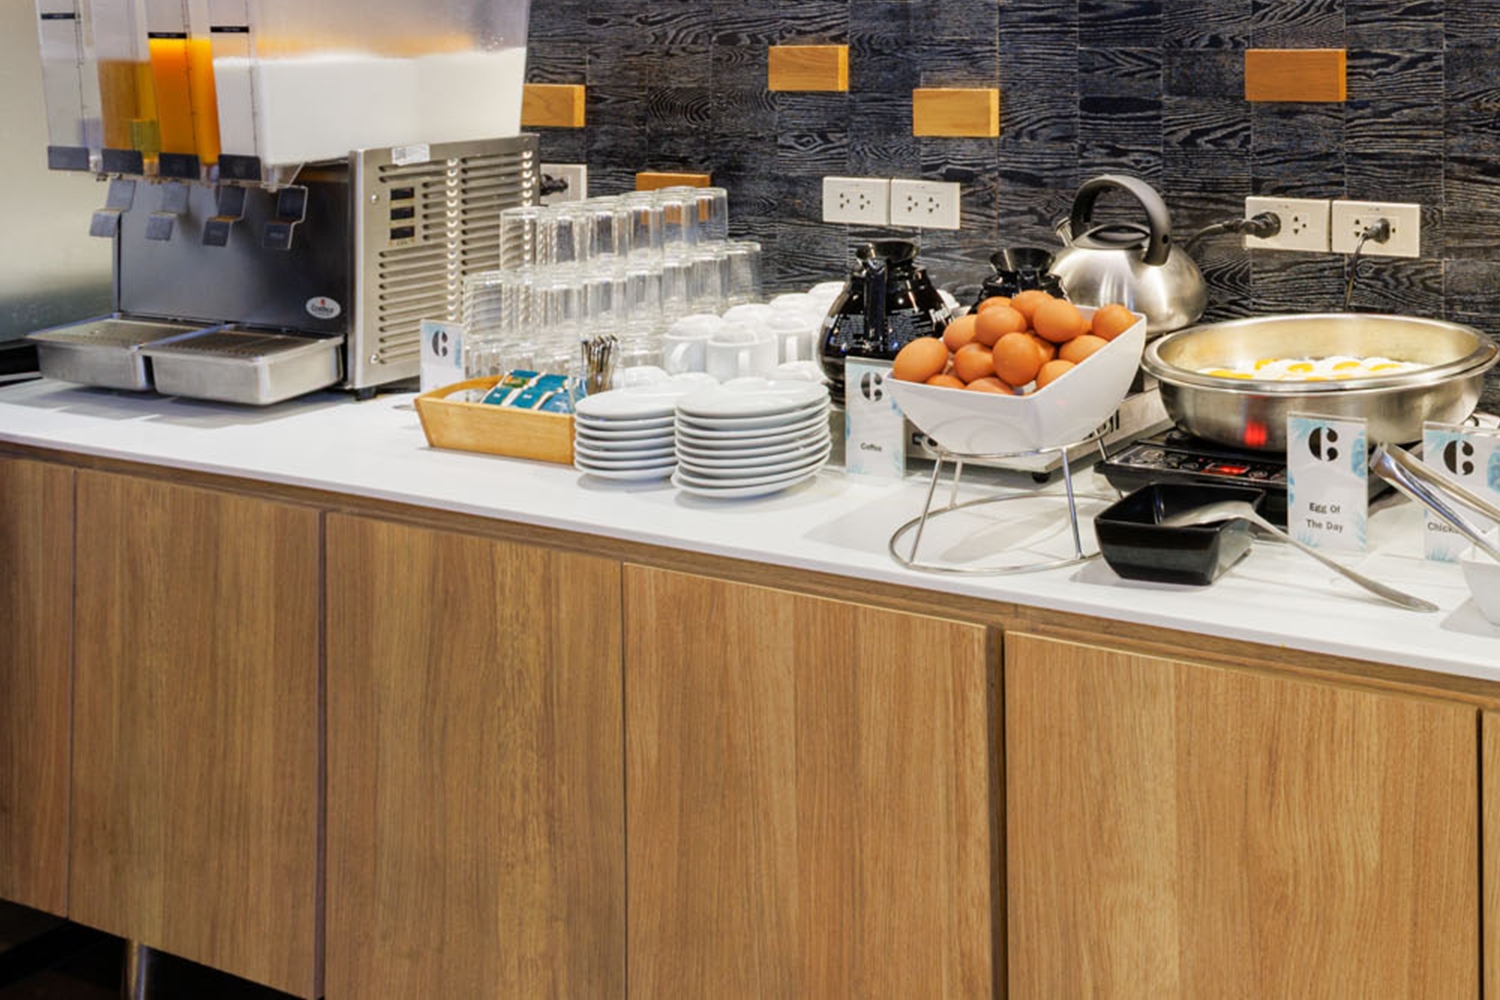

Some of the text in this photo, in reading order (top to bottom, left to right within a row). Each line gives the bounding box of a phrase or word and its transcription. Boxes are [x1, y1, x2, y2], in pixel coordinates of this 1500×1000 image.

[1309, 502, 1328, 515] Egg
[1306, 518, 1343, 534] The Day
